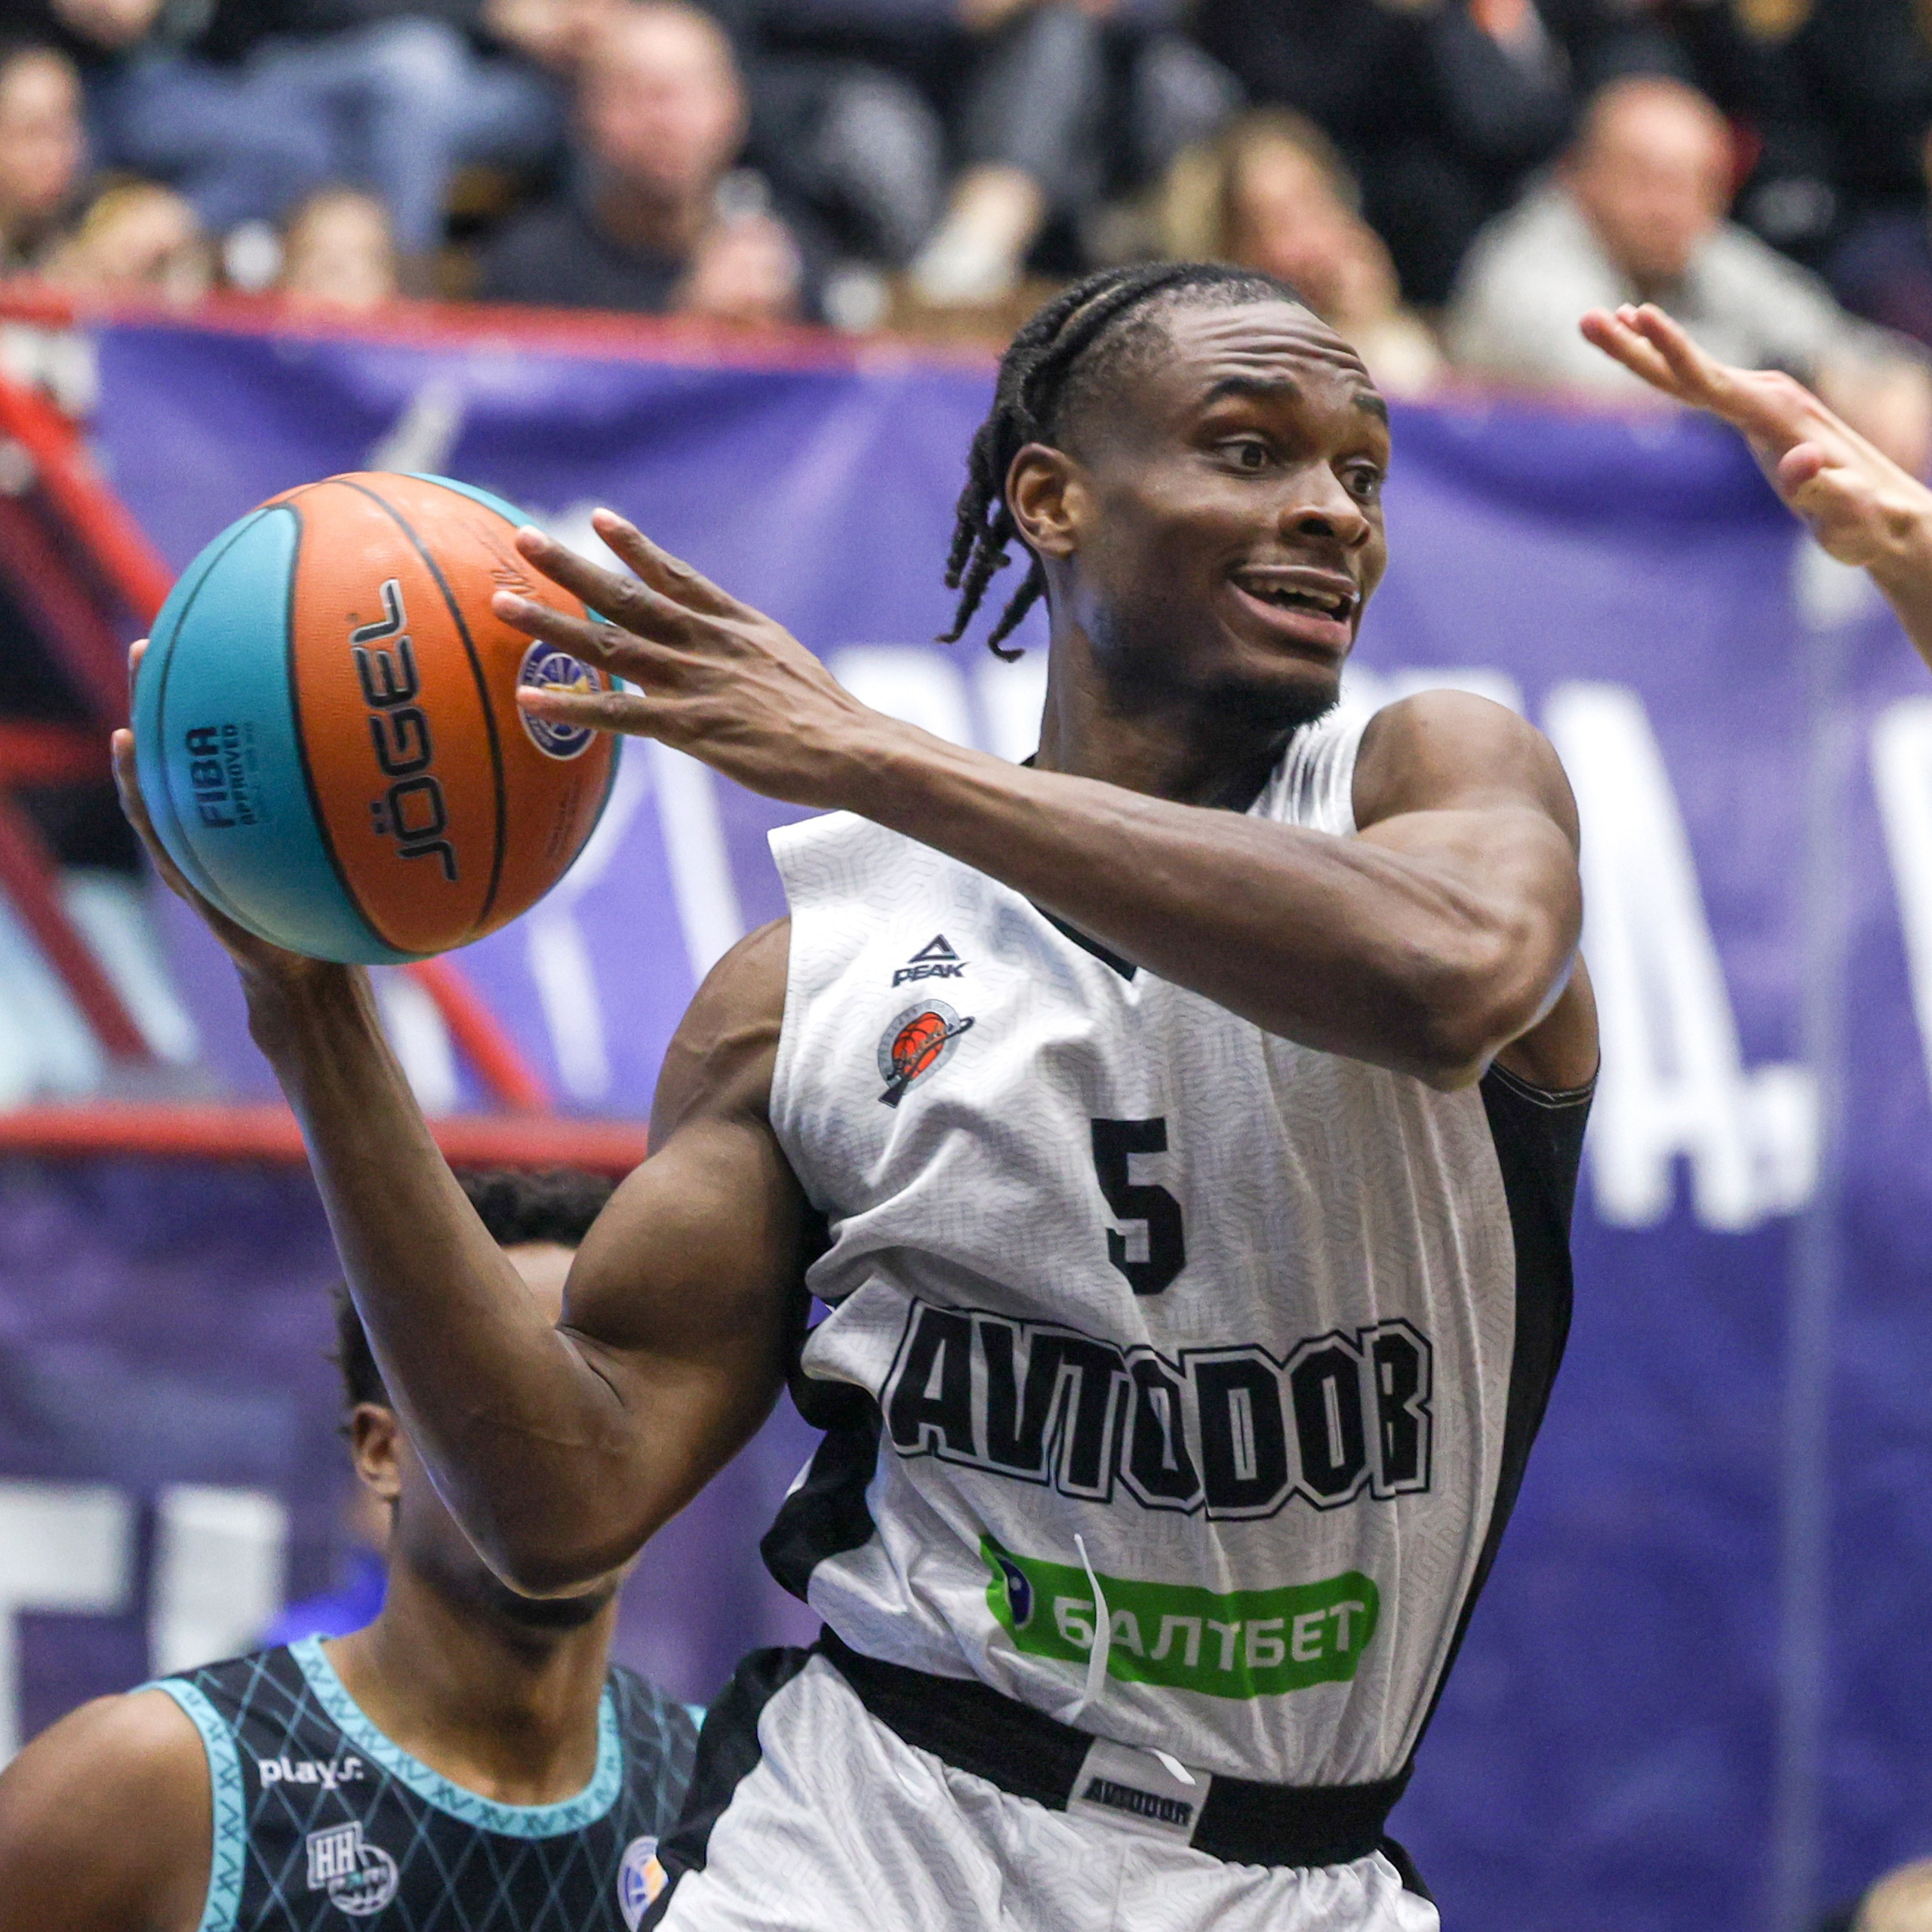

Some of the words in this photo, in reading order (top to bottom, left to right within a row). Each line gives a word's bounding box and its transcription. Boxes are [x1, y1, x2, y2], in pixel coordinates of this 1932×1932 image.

[186, 727, 235, 828] FIBA
[222, 724, 258, 825] APPROVED
[349, 577, 460, 882] JÖGEL
[891, 962, 971, 988] PEAK
[1091, 1117, 1186, 1295] 5
[878, 1297, 1432, 1522] AVTODOR
[1054, 1595, 1364, 1672] БАЛТБЕТ
